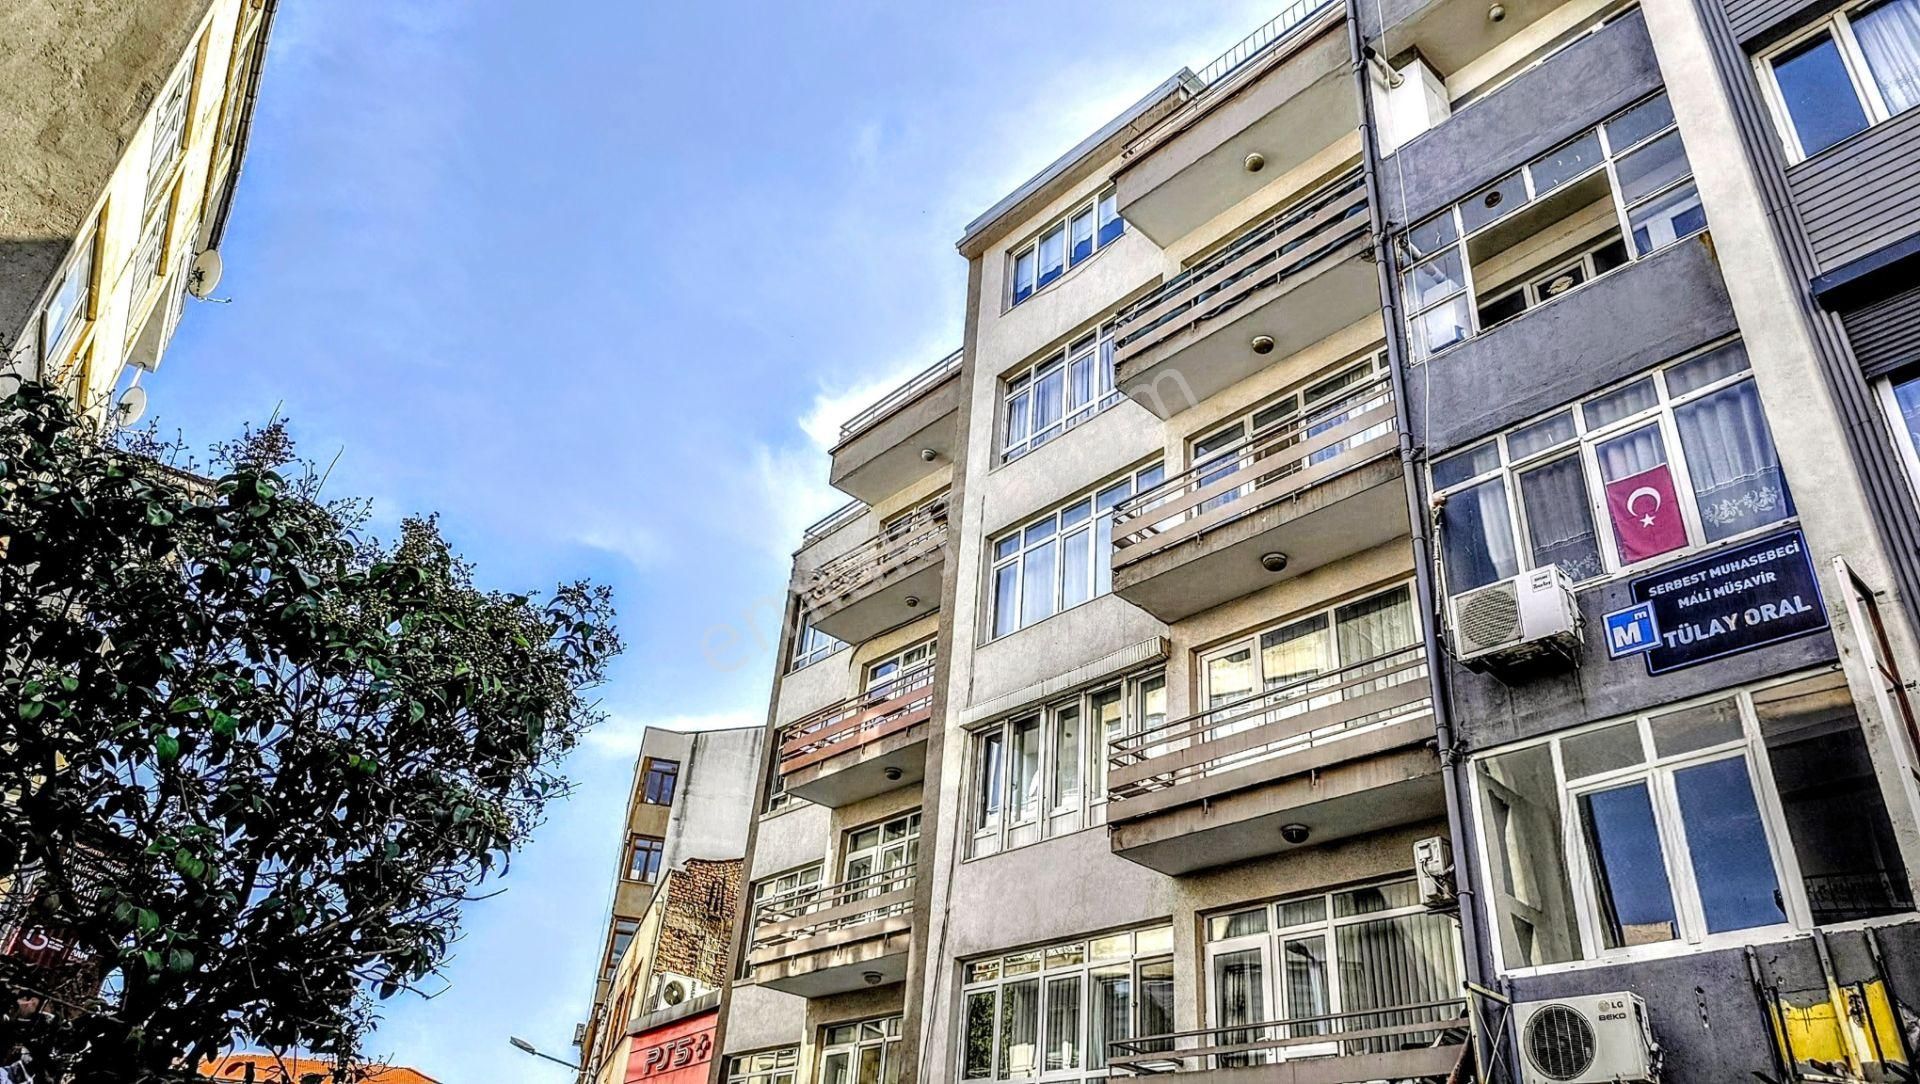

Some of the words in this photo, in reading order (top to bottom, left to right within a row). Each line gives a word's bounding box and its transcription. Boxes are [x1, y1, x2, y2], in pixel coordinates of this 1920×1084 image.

[1649, 571, 1707, 597] SERBEST
[1709, 540, 1800, 578] MUHASEBECİ
[1713, 571, 1777, 599] MÜŞAVİR
[1663, 612, 1739, 650] TÜLAY
[1743, 595, 1812, 628] ORAL
[1599, 1013, 1626, 1021] BEKO
[1611, 1001, 1624, 1009] LG
